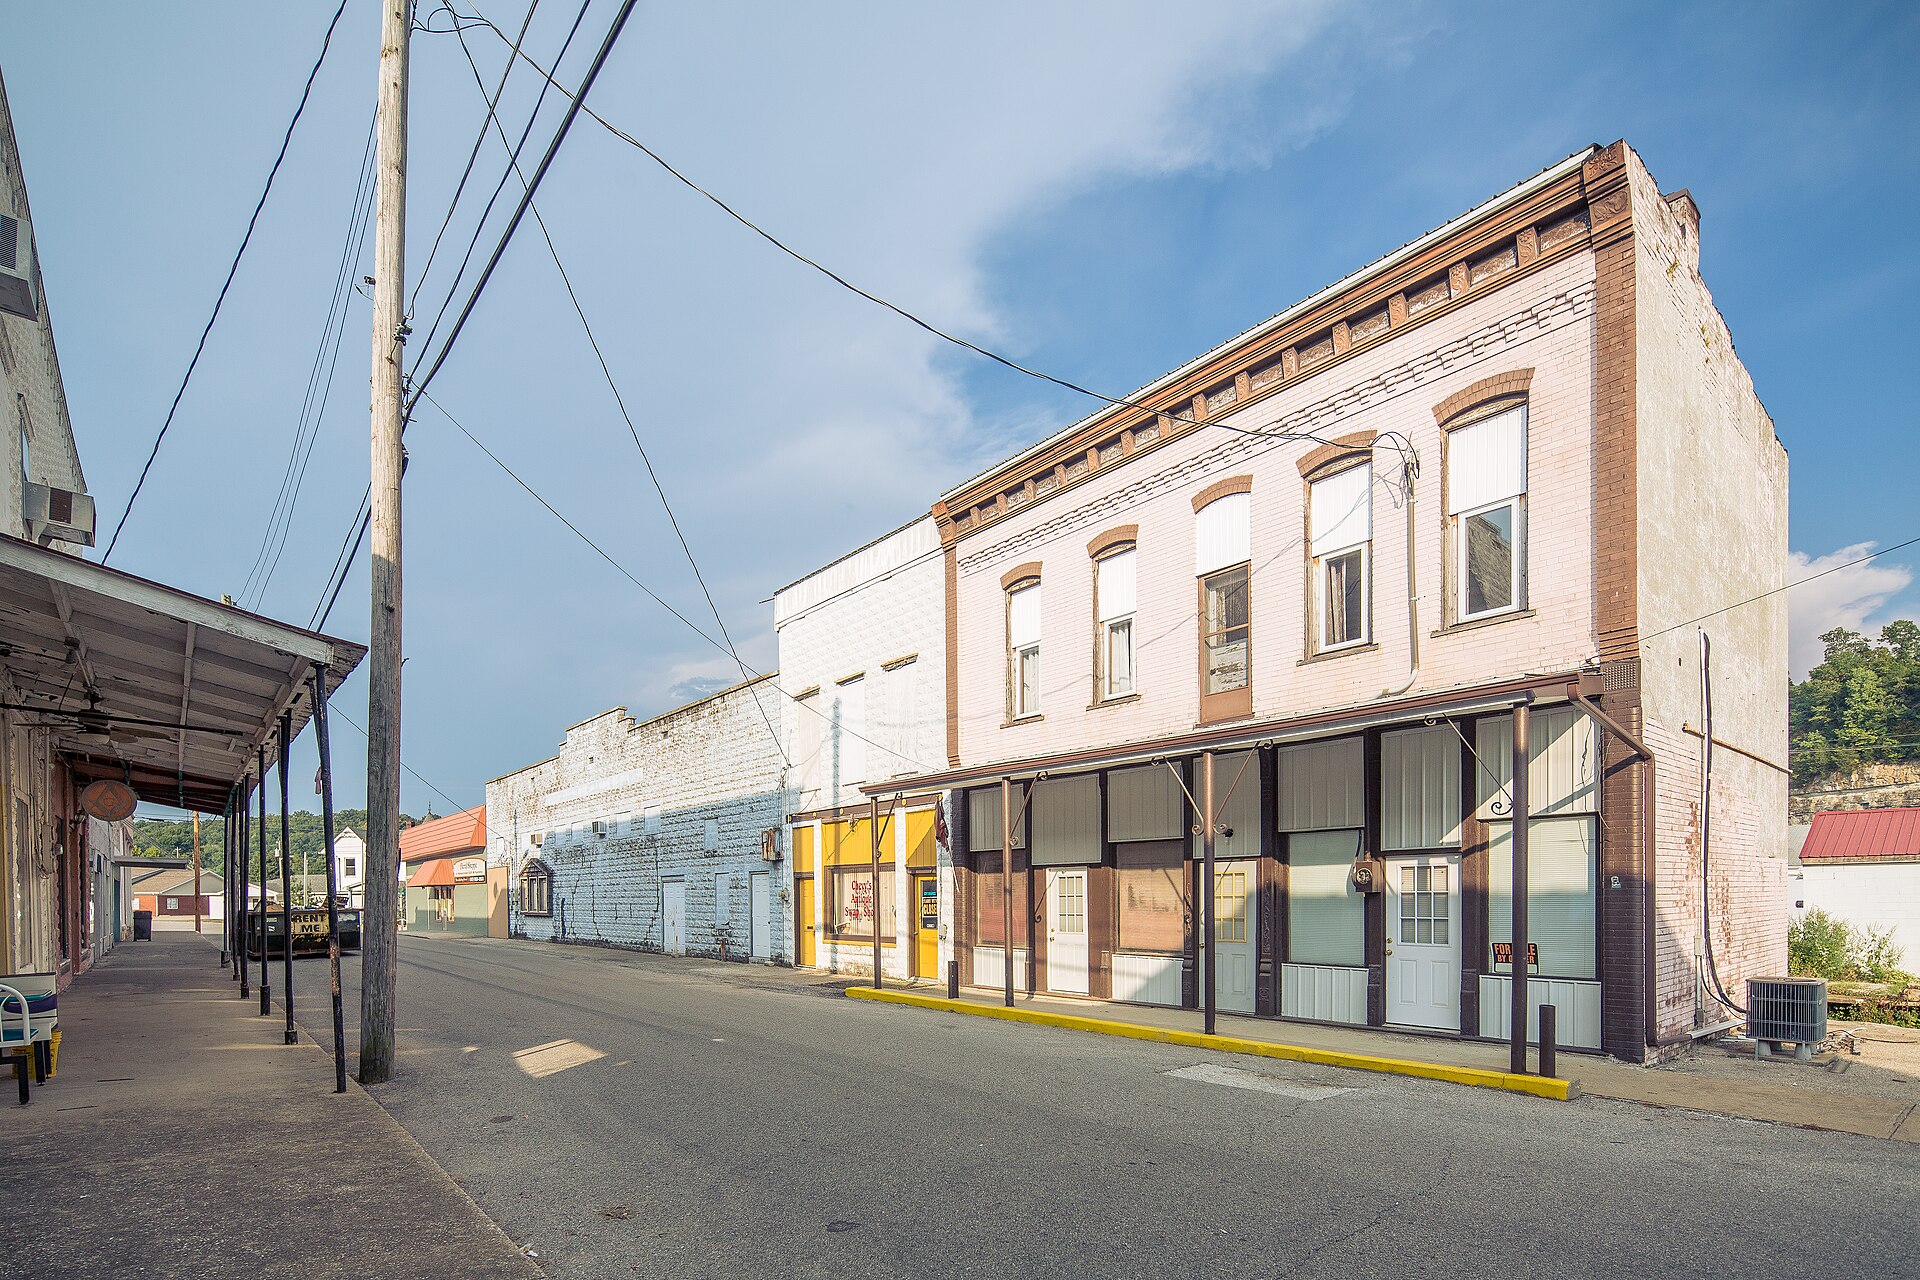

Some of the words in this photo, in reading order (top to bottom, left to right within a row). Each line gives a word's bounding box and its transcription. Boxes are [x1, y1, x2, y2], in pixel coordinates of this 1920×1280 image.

[851, 893, 872, 904] Antique
[845, 906, 859, 918] Swap
[863, 906, 875, 917] Sho
[294, 914, 326, 923] RENT
[301, 924, 320, 933] ME
[1494, 944, 1511, 955] FOR
[1497, 954, 1506, 963] BY
